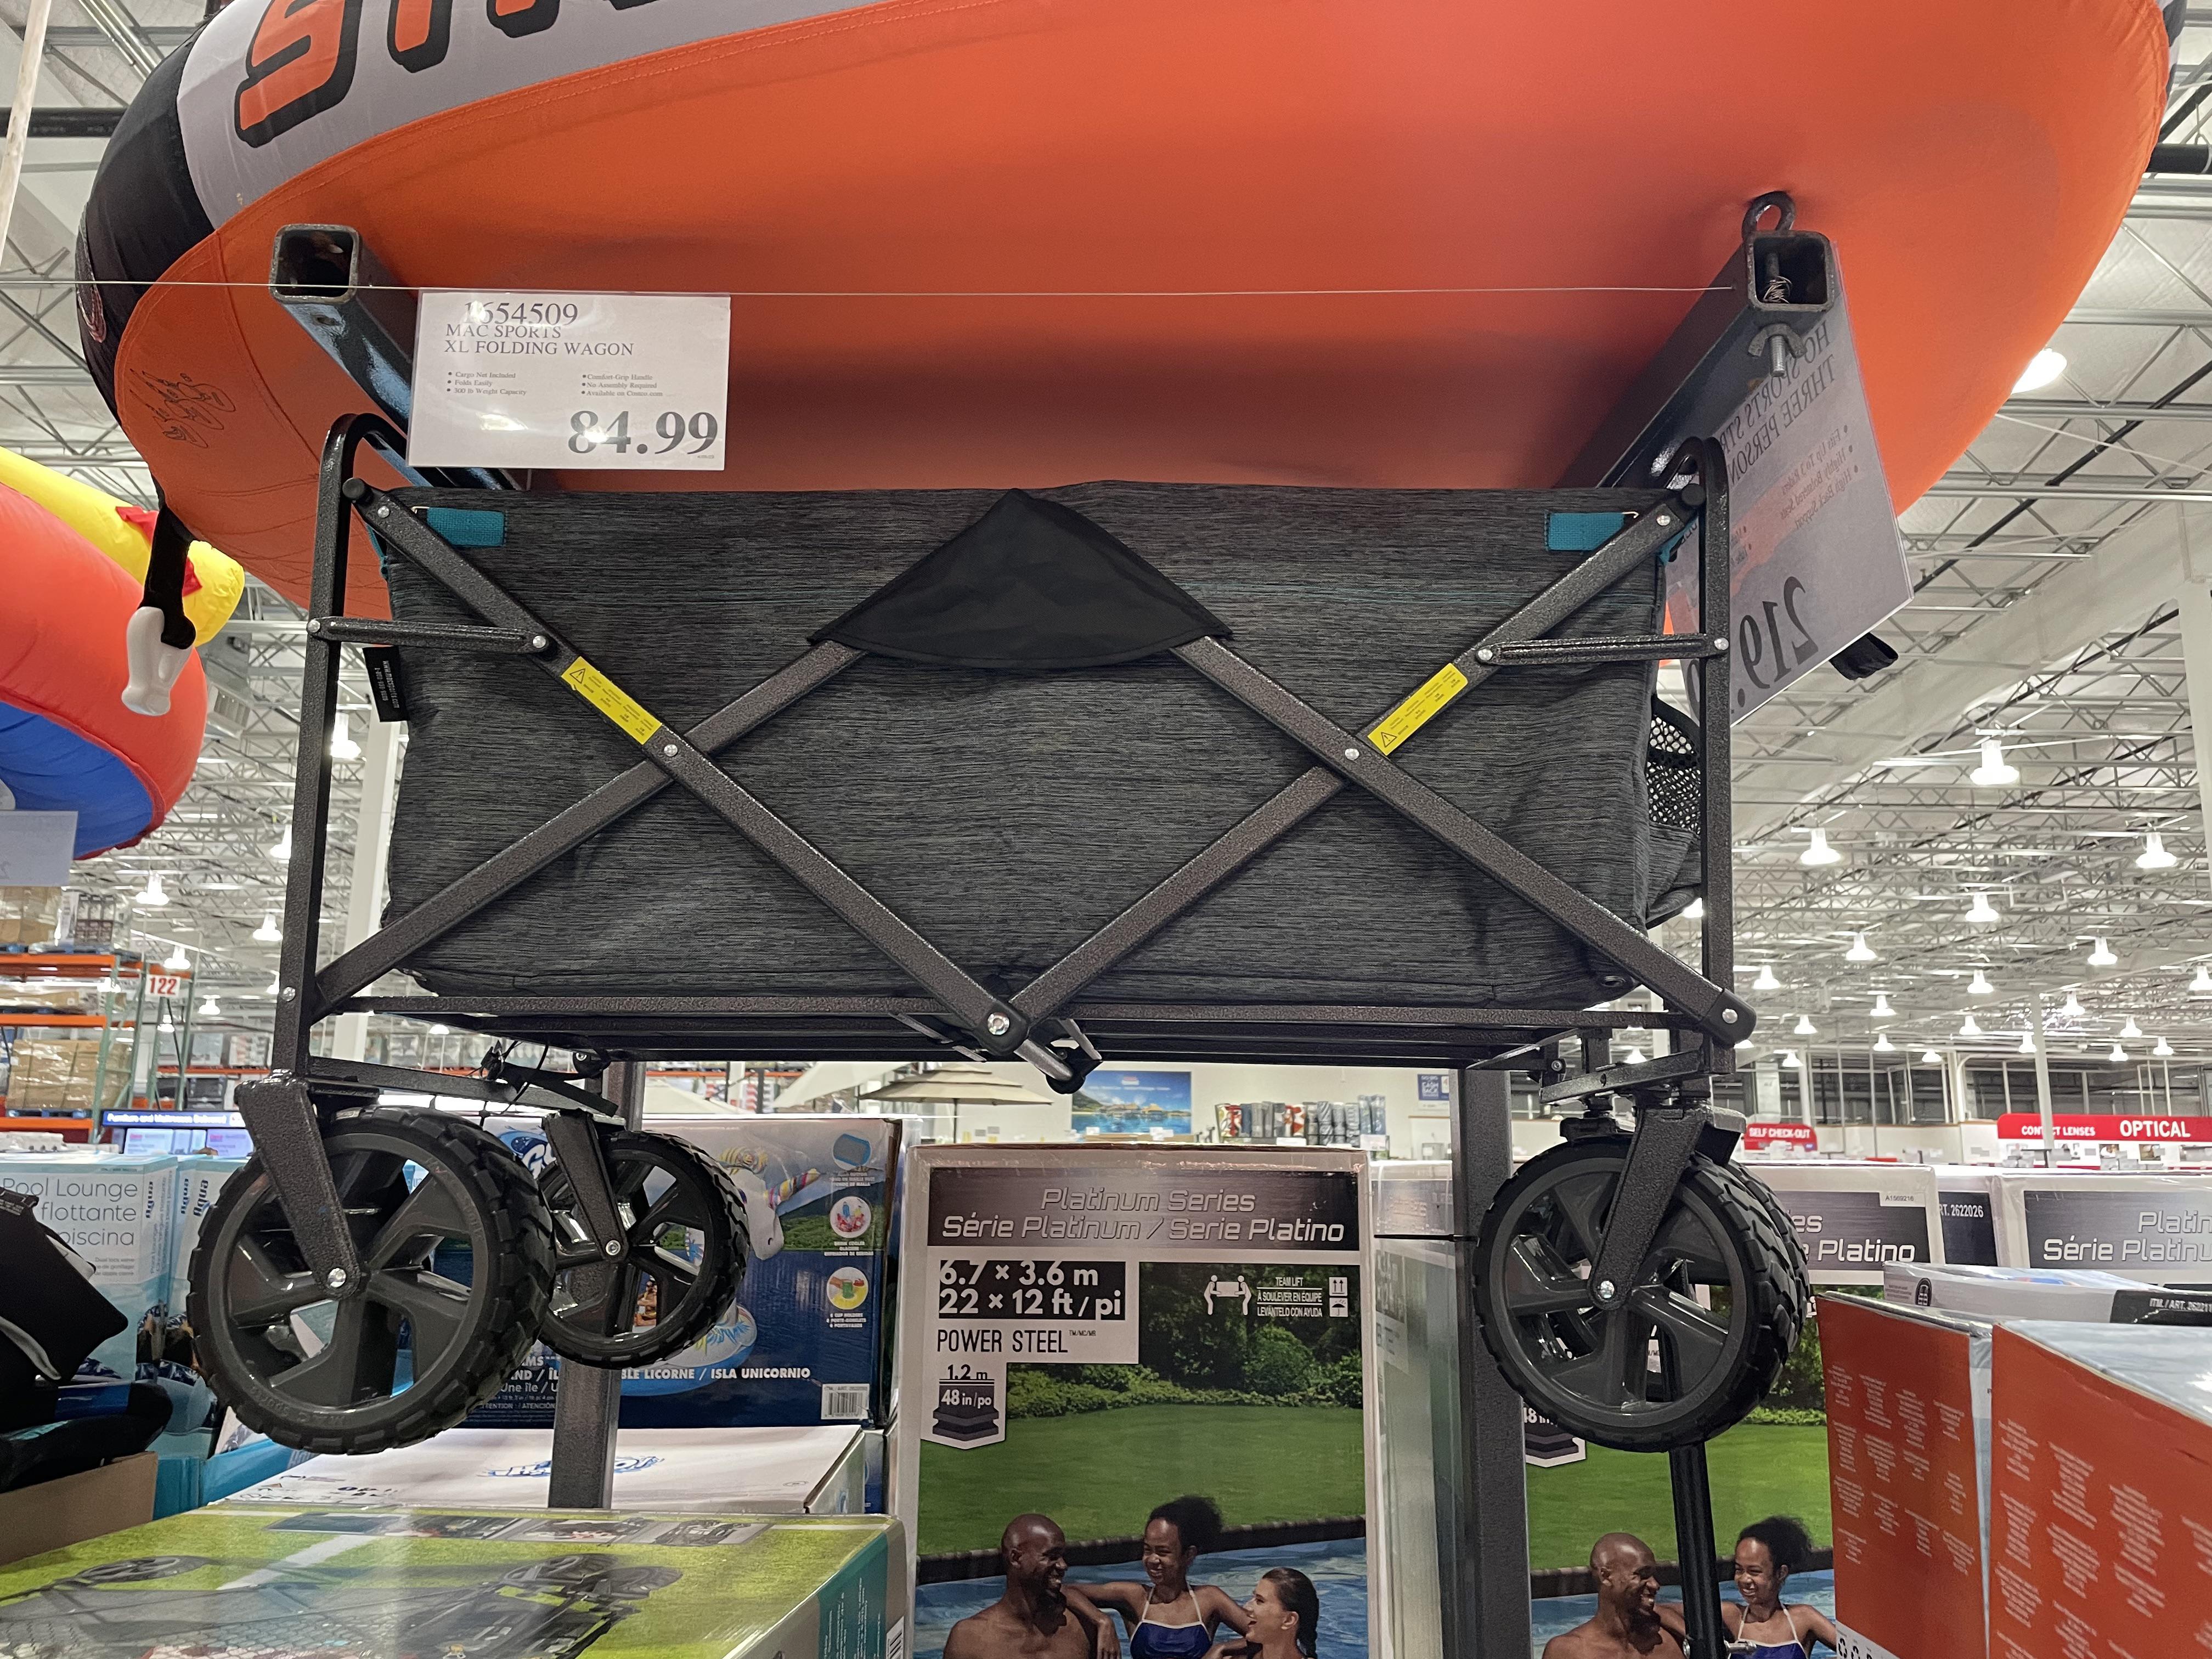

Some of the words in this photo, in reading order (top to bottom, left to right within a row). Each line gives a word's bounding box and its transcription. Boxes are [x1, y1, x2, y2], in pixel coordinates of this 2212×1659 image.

[465, 302, 578, 326] 1654509
[445, 324, 488, 337] MAC
[494, 325, 562, 338] SPORTS
[444, 340, 469, 353] XL
[475, 341, 558, 355] FOLDING
[564, 342, 635, 356] WAGON
[568, 410, 719, 455] 84.99
[149, 977, 177, 995] 122
[1749, 1127, 1767, 1137] SELF
[1768, 1128, 1810, 1138] CHECK-OUT
[2021, 1125, 2061, 1136] CONTCT
[2063, 1126, 2096, 1136] LENSES
[2119, 1120, 2191, 1138] OPTICAL
[57, 1178, 138, 1202] Lounge
[1041, 1187, 1160, 1212] Platinum
[1167, 1188, 1256, 1213] Series
[42, 1201, 137, 1222] flottante
[1951, 1204, 1984, 1218] 2622026
[941, 1211, 1014, 1238] Série
[1020, 1214, 1141, 1240] Platinum
[1146, 1217, 1164, 1241] /
[1169, 1216, 1240, 1242] Serie
[1248, 1218, 1344, 1243] Platino
[1818, 1238, 1916, 1262] Platino
[2043, 1235, 2114, 1261] Série
[940, 1260, 988, 1285] 6.7
[1019, 1261, 1065, 1286] 3.6
[1073, 1268, 1098, 1286] m
[1275, 1277, 1291, 1286] TEAM
[1291, 1277, 1304, 1286] LIFT
[939, 1288, 979, 1314] 22
[1012, 1289, 1043, 1314] 12
[1052, 1288, 1074, 1315] ft
[1096, 1290, 1121, 1321] pi
[1262, 1291, 1292, 1302] SOULEVER
[1293, 1292, 1301, 1302] EN
[1257, 1305, 1289, 1317] LEVÁNTELO
[1290, 1307, 1303, 1317] CON
[1304, 1307, 1323, 1317] AYUDA
[937, 1329, 1002, 1352] POWER
[1012, 1330, 1068, 1353] STEEL
[621, 1368, 640, 1380] BLE
[644, 1368, 695, 1380] LICORNE
[710, 1368, 737, 1379] ISLA
[740, 1367, 810, 1379] UNICORNIO
[947, 1364, 970, 1380] 1.2
[976, 1372, 988, 1380] m
[941, 1389, 960, 1406] 48
